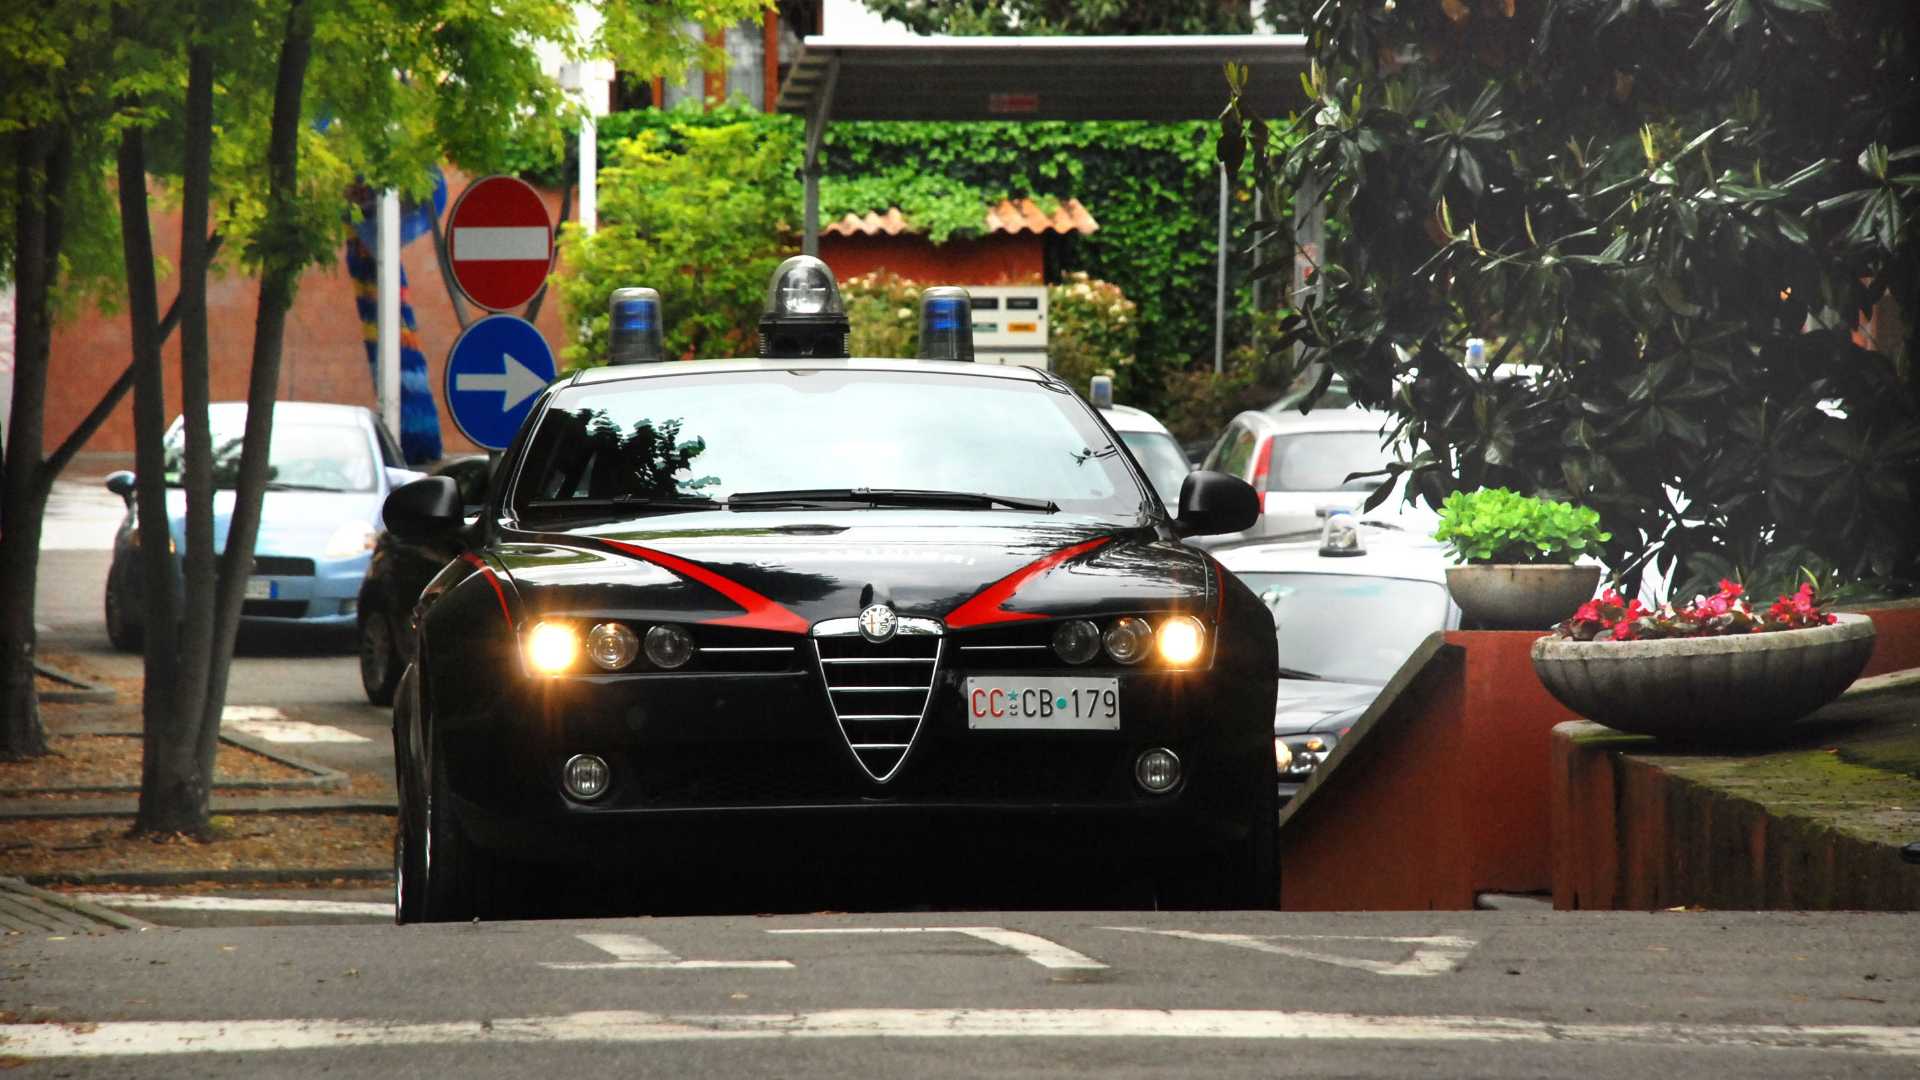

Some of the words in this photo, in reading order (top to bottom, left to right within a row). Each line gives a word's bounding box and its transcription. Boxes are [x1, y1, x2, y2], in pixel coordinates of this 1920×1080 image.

[972, 688, 1004, 718] CC
[1022, 689, 1053, 718] CB
[1072, 689, 1116, 718] 179
